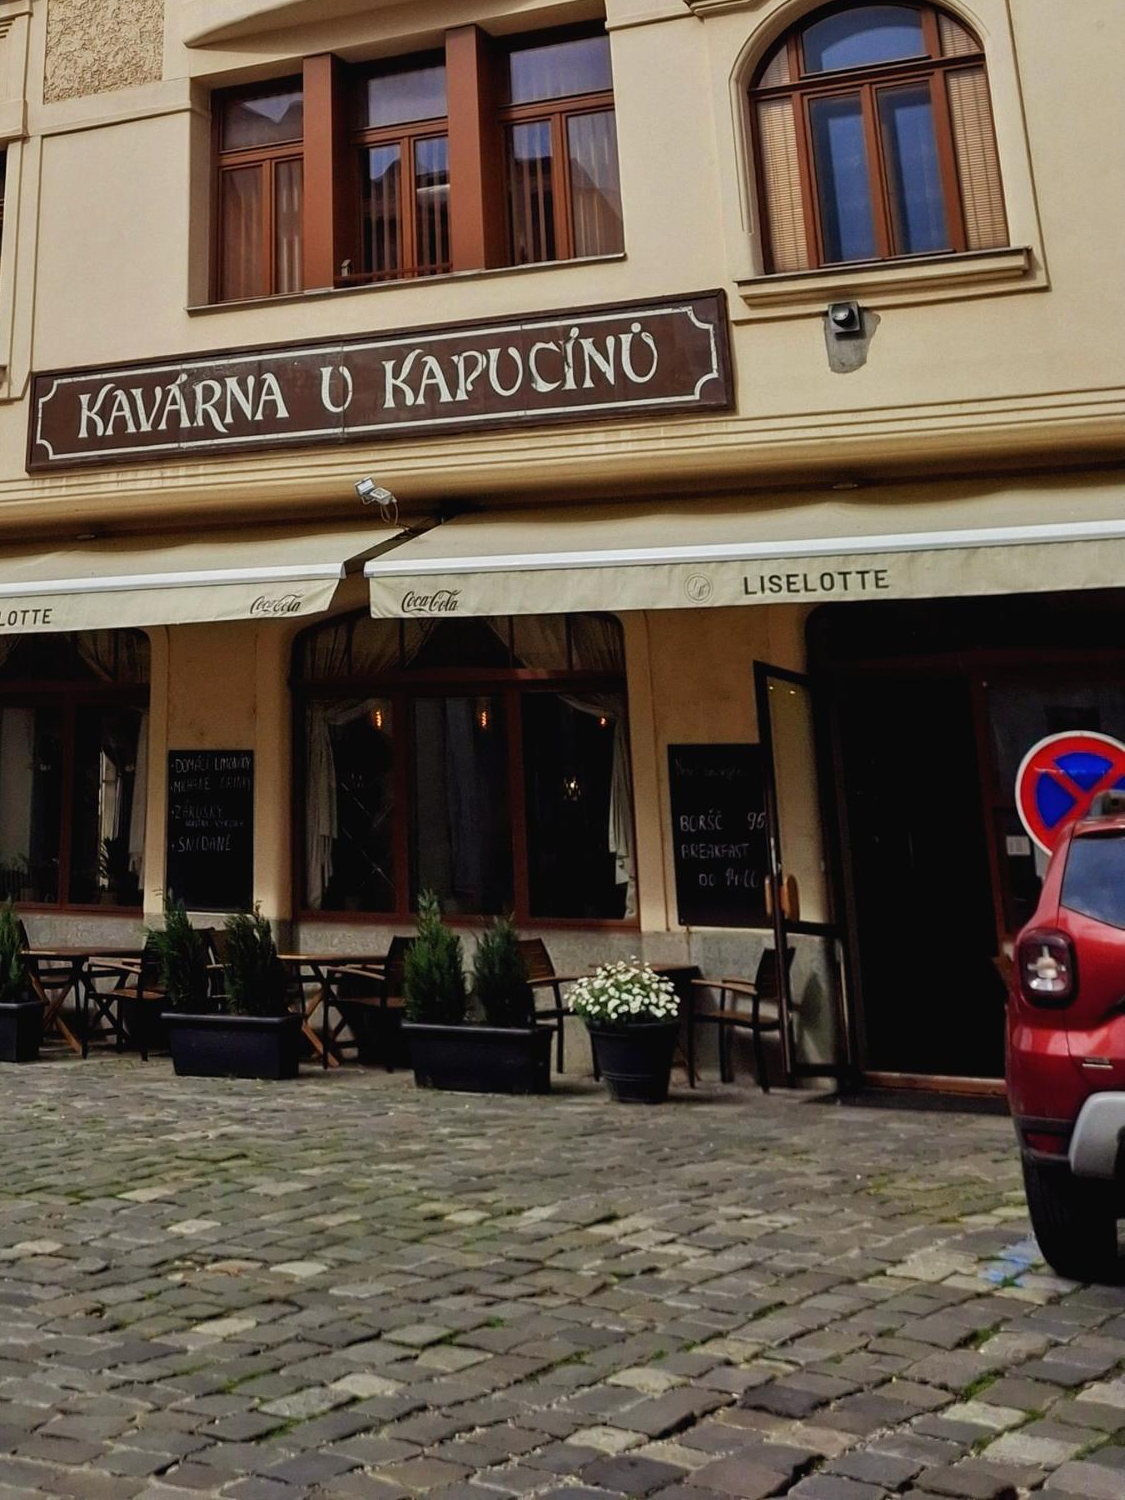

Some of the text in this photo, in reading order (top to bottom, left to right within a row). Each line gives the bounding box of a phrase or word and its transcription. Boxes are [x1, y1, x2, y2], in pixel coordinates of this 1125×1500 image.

[78, 373, 289, 438] KAVÁRNA
[320, 365, 353, 413] U
[744, 569, 890, 596] LISELOTTE
[401, 589, 462, 613] Coca-Cola
